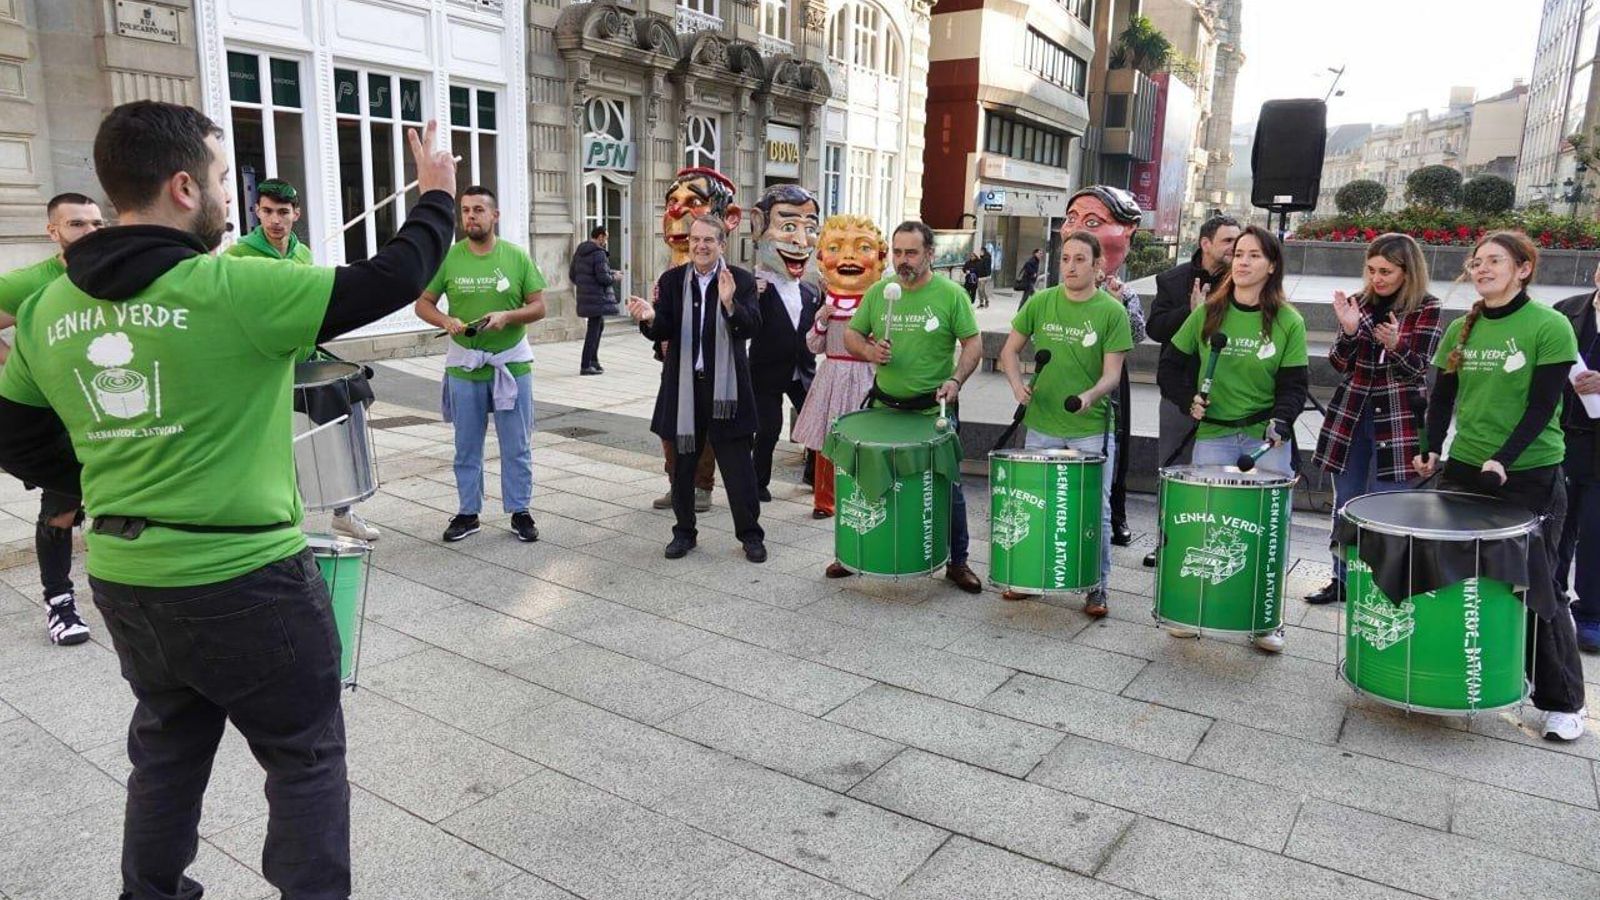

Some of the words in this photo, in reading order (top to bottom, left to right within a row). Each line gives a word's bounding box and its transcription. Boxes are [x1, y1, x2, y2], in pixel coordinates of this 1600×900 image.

[119, 21, 159, 33] POLICARPO
[140, 18, 156, 26] RUA
[587, 141, 629, 168] PSN
[770, 140, 800, 164] BBVA
[48, 306, 106, 346] LENHA
[112, 303, 190, 329] VERDE
[1235, 337, 1261, 348] VERDE
[1481, 350, 1507, 360] VERDE
[1009, 488, 1046, 509] VERDE
[1053, 464, 1068, 588] @LENHAVERDE_BATUCADA
[1173, 512, 1216, 524] LENHA
[1221, 515, 1266, 536] VERDE
[1264, 488, 1281, 624] @LENHAVERDE_BATUCADA
[1346, 559, 1373, 573] ENHA
[1463, 577, 1482, 704] NHAVERDE_BATUCADA
